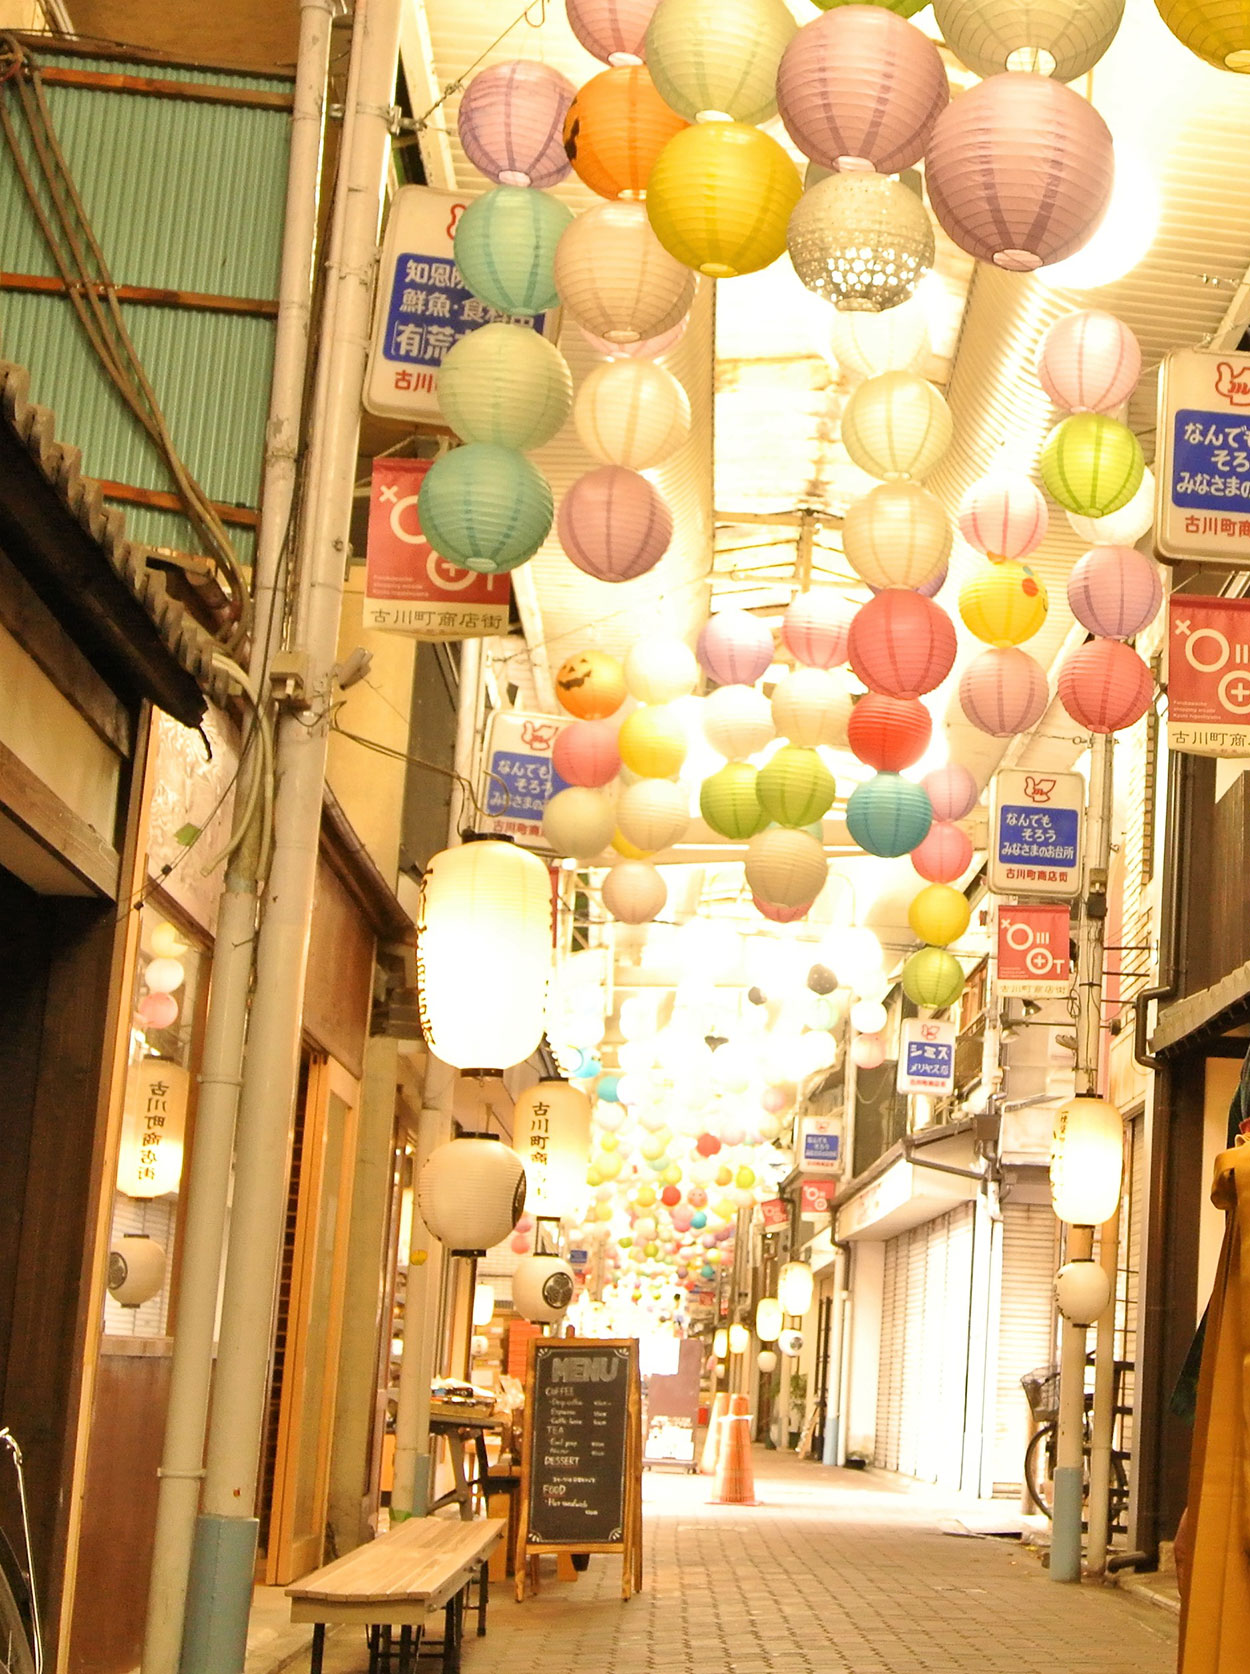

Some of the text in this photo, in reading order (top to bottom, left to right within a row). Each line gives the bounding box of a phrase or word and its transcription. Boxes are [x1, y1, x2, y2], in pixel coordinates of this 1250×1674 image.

[370, 608, 503, 630] 古川町商店街
[1006, 812, 1052, 828] なんでも
[1021, 828, 1056, 843] そろう
[1001, 842, 1074, 860] みなさまのお台所
[552, 1357, 619, 1383] MENU
[546, 1425, 564, 1435] TEA
[544, 1455, 580, 1466] DESSERT
[543, 1484, 566, 1495] FOOD
